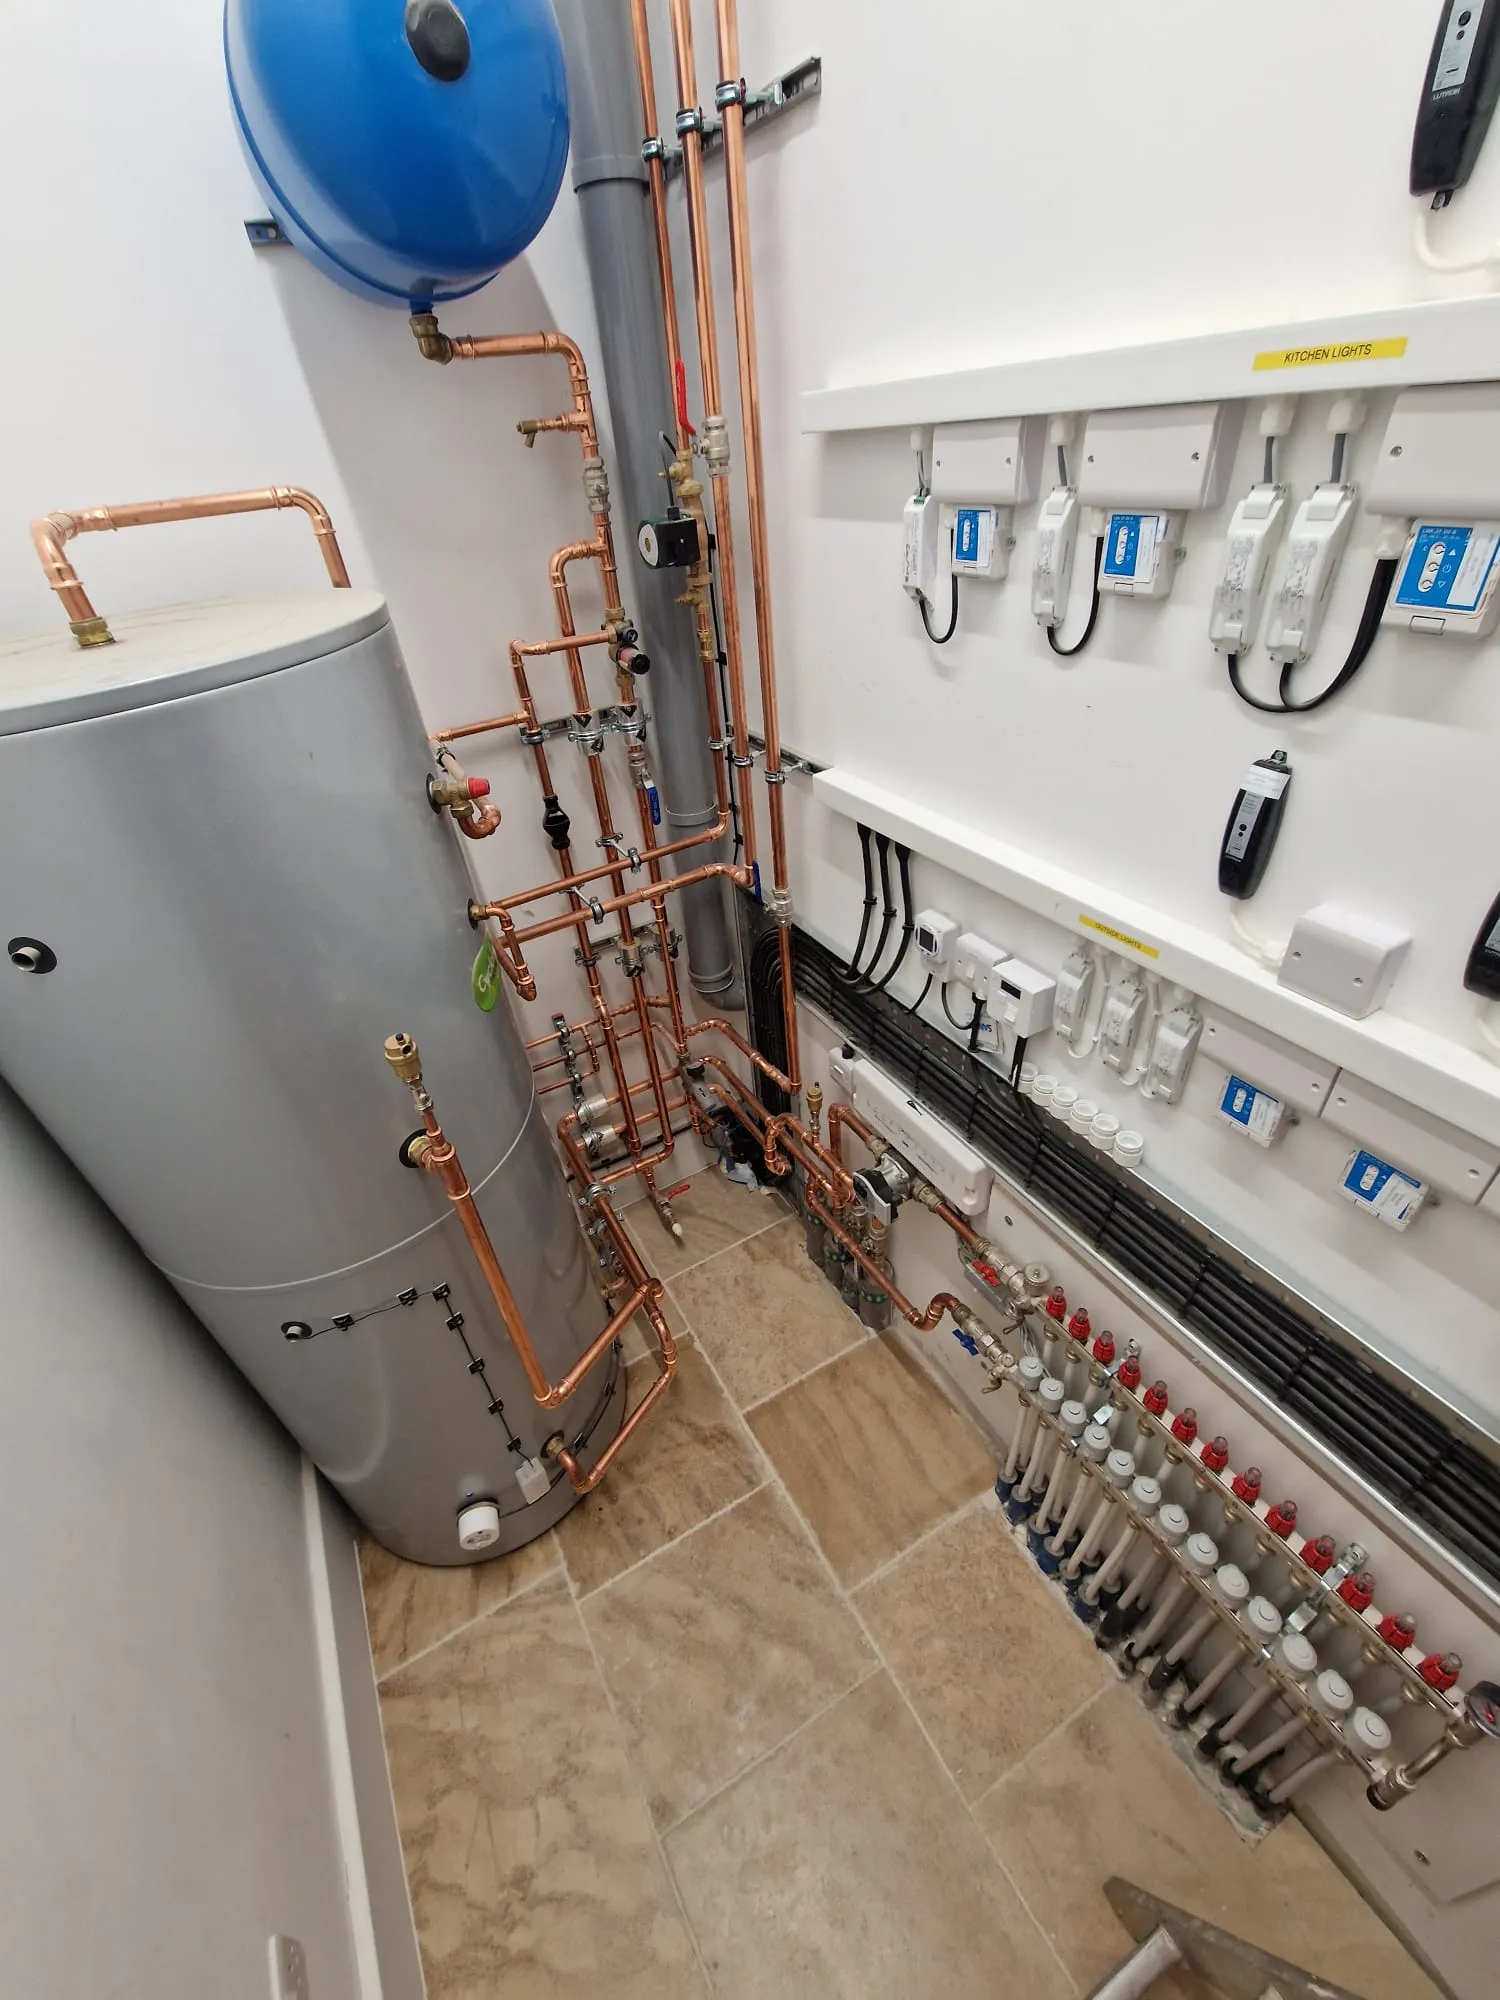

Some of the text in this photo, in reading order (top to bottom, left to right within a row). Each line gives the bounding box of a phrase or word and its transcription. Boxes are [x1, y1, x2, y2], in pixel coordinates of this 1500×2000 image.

[1432, 87, 1461, 101] LUTRON
[1284, 343, 1372, 364] KITCHEN LIGHTS
[1095, 922, 1143, 949] OUTSIDE LIGHTS
